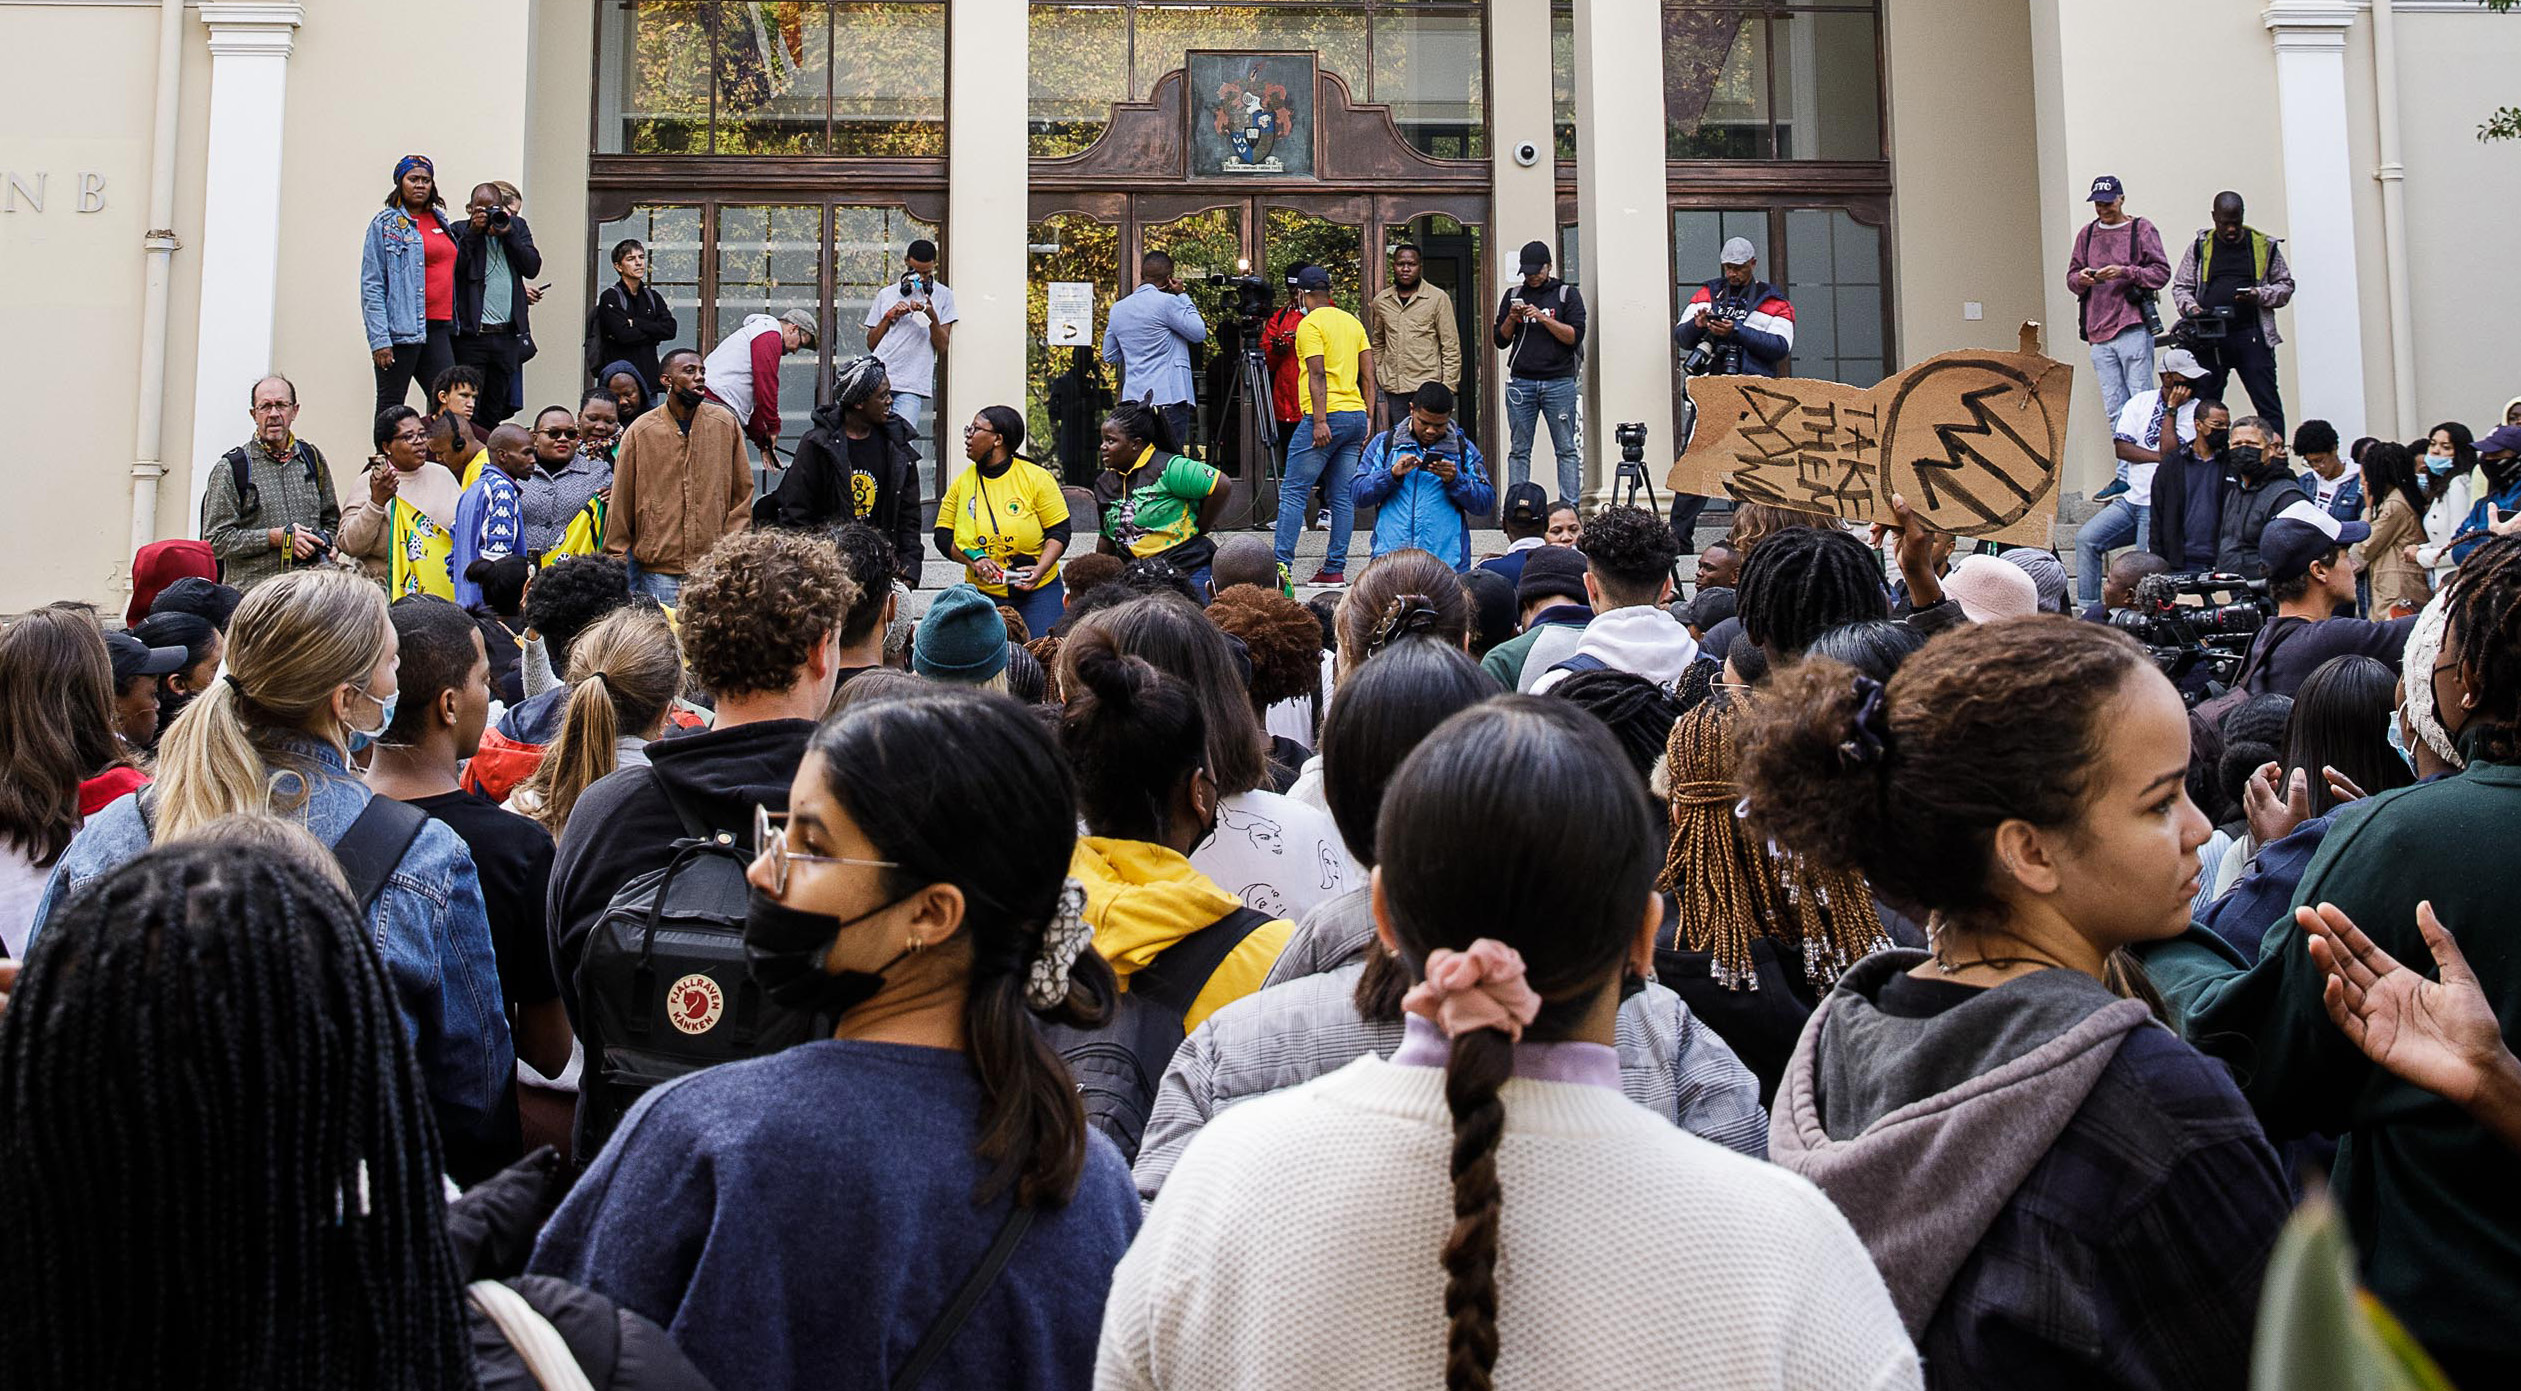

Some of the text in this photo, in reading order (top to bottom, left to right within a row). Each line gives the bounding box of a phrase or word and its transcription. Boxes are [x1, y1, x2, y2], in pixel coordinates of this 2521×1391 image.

[76, 171, 106, 214] B
[1797, 402, 1838, 515] THEM
[1836, 403, 1878, 520] TAKE
